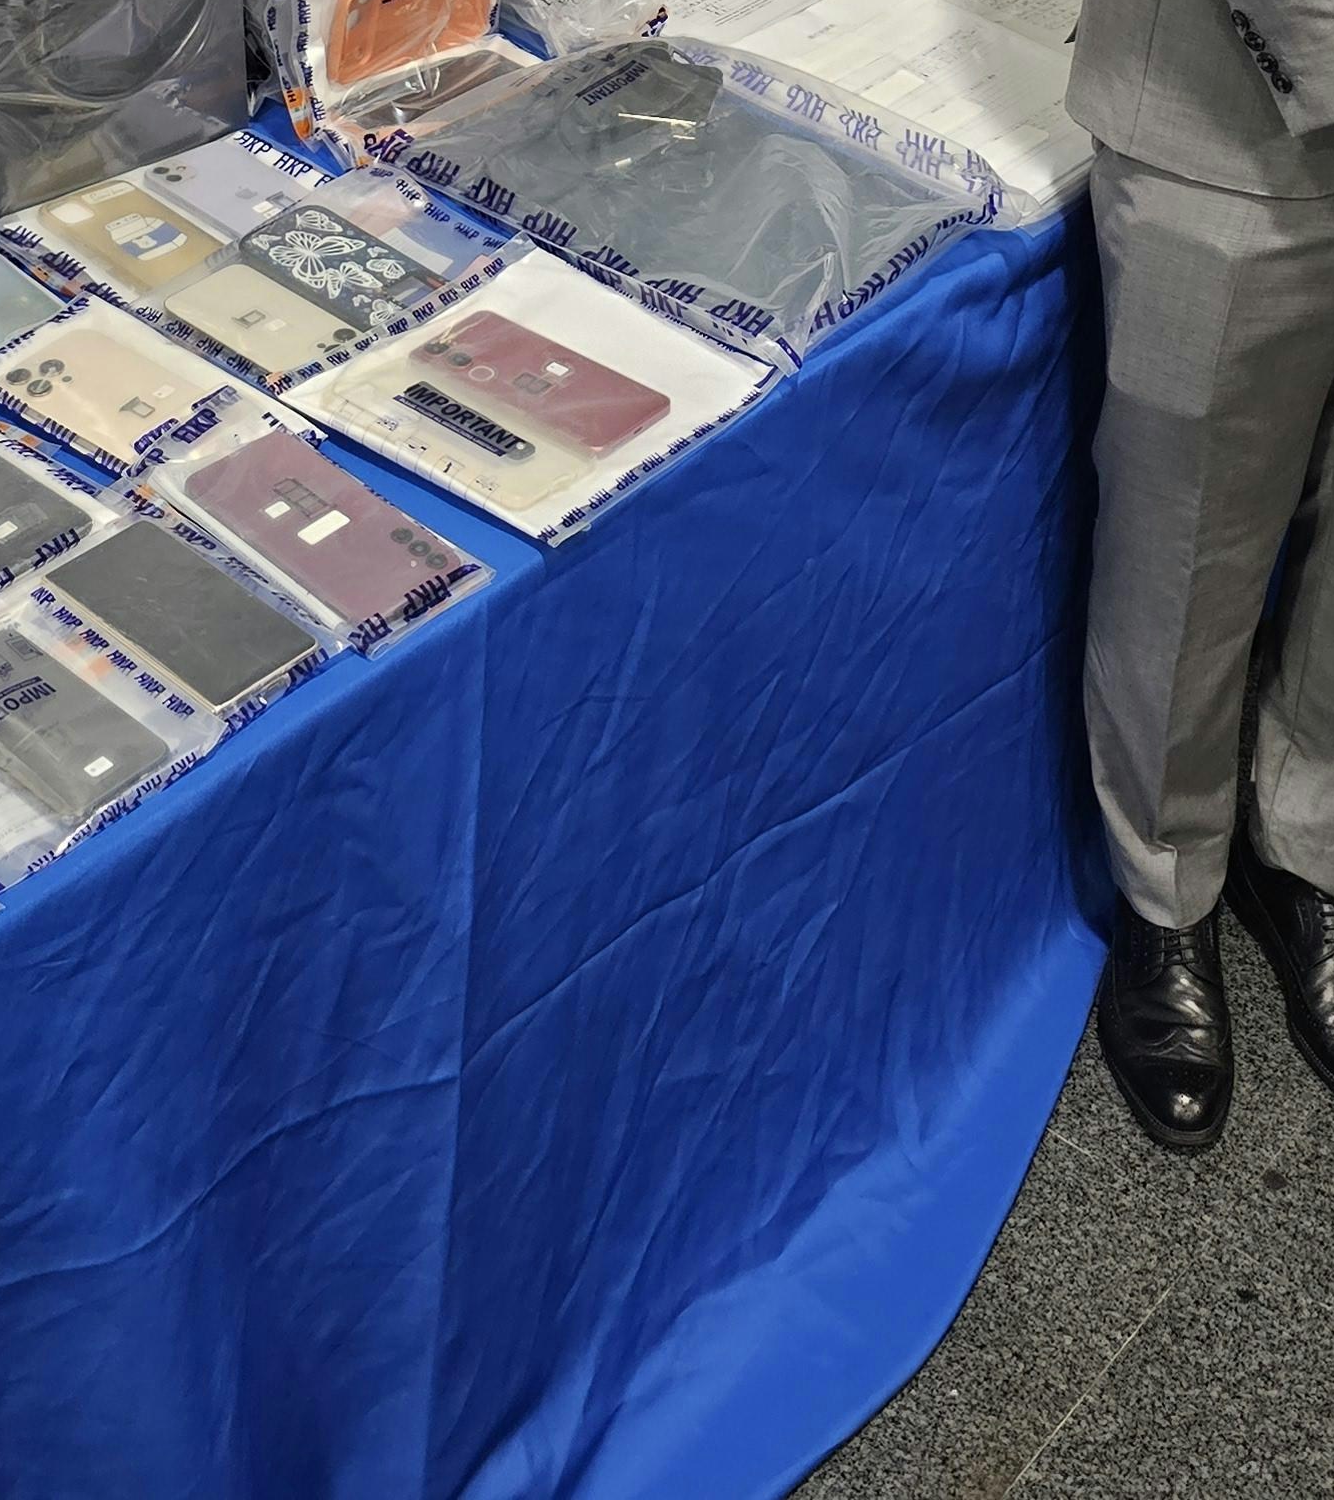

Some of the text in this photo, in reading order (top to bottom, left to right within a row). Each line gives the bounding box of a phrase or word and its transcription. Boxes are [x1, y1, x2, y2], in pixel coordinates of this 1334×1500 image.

[581, 61, 649, 106] IMPORTANT
[273, 152, 314, 178] HKP
[424, 202, 450, 224] HKP
[483, 236, 505, 250] HK
[465, 177, 516, 215] HKP
[707, 299, 775, 338] HKP
[197, 337, 222, 357] HKP
[403, 384, 525, 450] IMPORTANT
